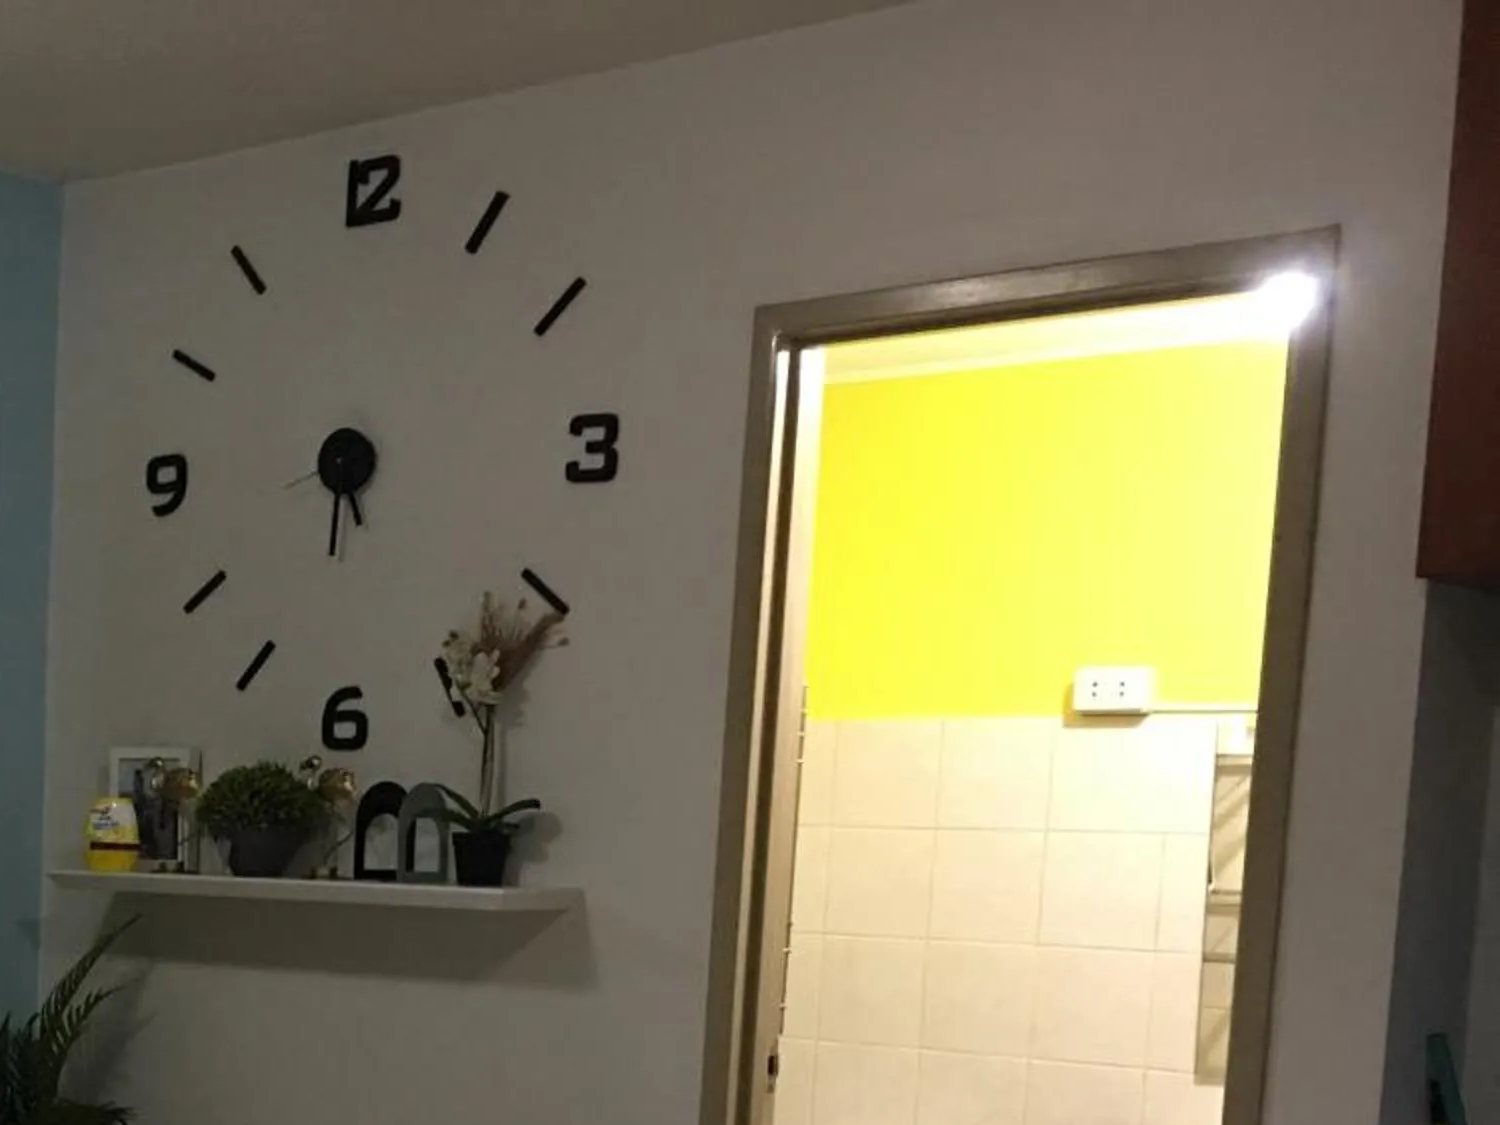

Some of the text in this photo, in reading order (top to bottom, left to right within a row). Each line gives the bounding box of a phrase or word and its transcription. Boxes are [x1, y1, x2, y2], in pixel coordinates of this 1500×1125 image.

[565, 413, 620, 484] 3
[146, 453, 189, 519] 9
[321, 686, 369, 751] 6
